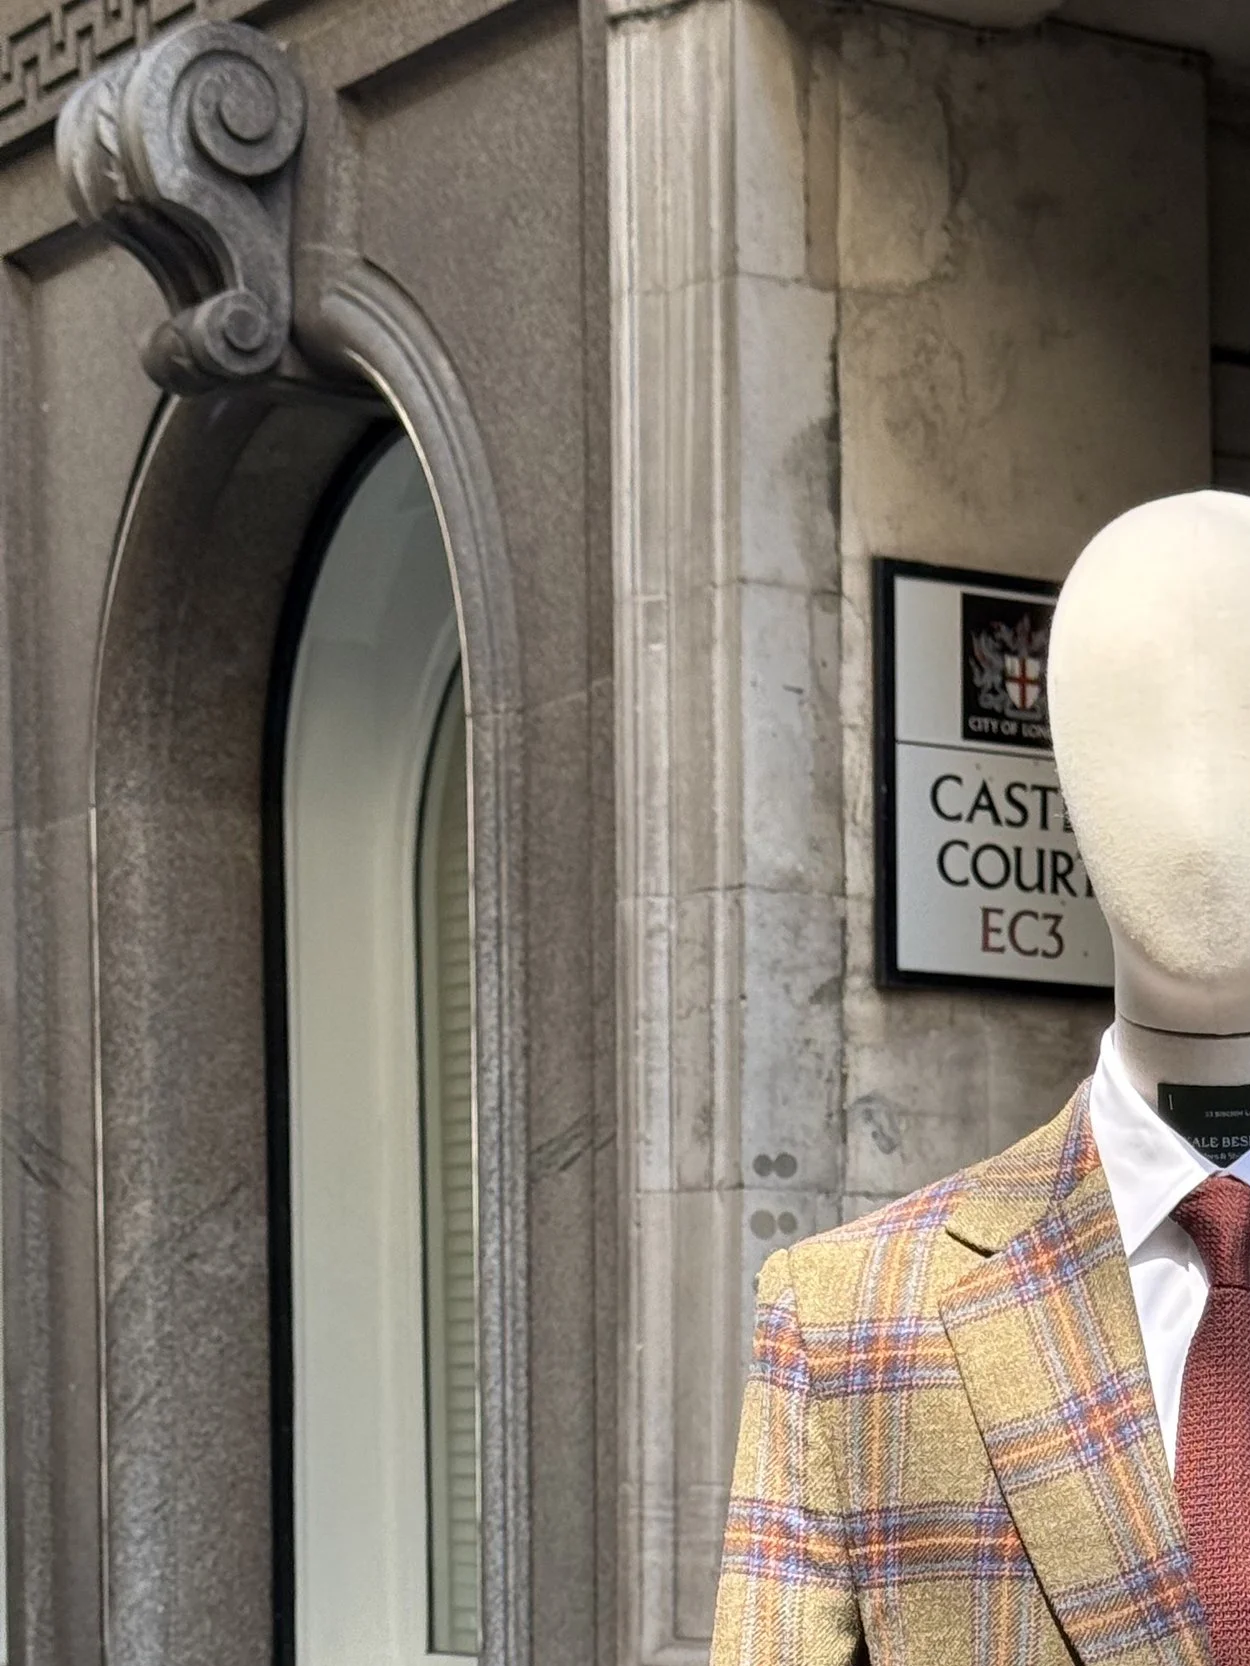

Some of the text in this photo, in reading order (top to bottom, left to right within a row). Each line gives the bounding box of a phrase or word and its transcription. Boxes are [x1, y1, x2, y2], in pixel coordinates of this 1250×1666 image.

[968, 716, 999, 735] CITY
[1000, 720, 1018, 737] OF
[930, 774, 1076, 834] CAST
[981, 906, 1065, 960] EC3
